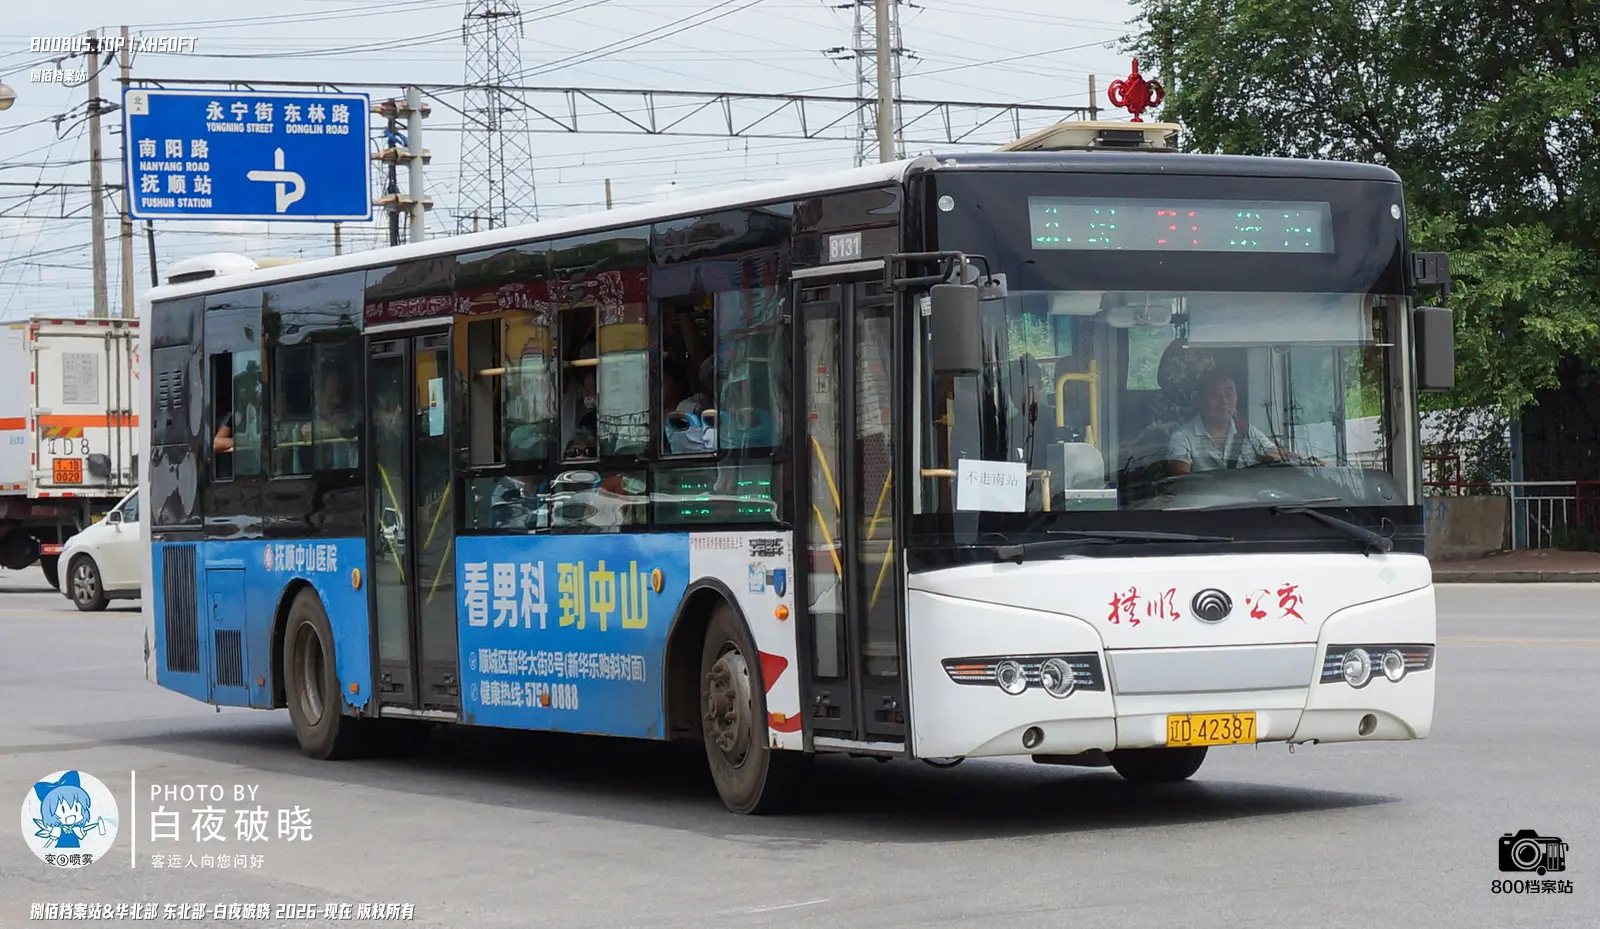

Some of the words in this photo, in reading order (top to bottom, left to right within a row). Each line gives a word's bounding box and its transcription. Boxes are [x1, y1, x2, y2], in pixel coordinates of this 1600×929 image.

[206, 101, 273, 122] 永宁街
[284, 103, 350, 123] 东林路
[206, 122, 244, 133] YONGNING
[246, 123, 273, 134] STREET
[286, 124, 323, 134] DONGLIN
[326, 124, 349, 135] ROAD
[138, 138, 209, 158] 南阳路
[140, 161, 182, 172] NANYANG
[186, 161, 210, 172] ROAD
[140, 174, 212, 194] 抚顺站
[141, 197, 175, 208] FUSHUN
[177, 197, 212, 208] STATION
[830, 236, 860, 260] 8131
[56, 472, 79, 482] 0029
[966, 471, 1019, 486] 不走南站
[275, 544, 338, 572] 抚顺中山医院
[464, 560, 548, 629] 看男科
[557, 560, 648, 631] 到中山
